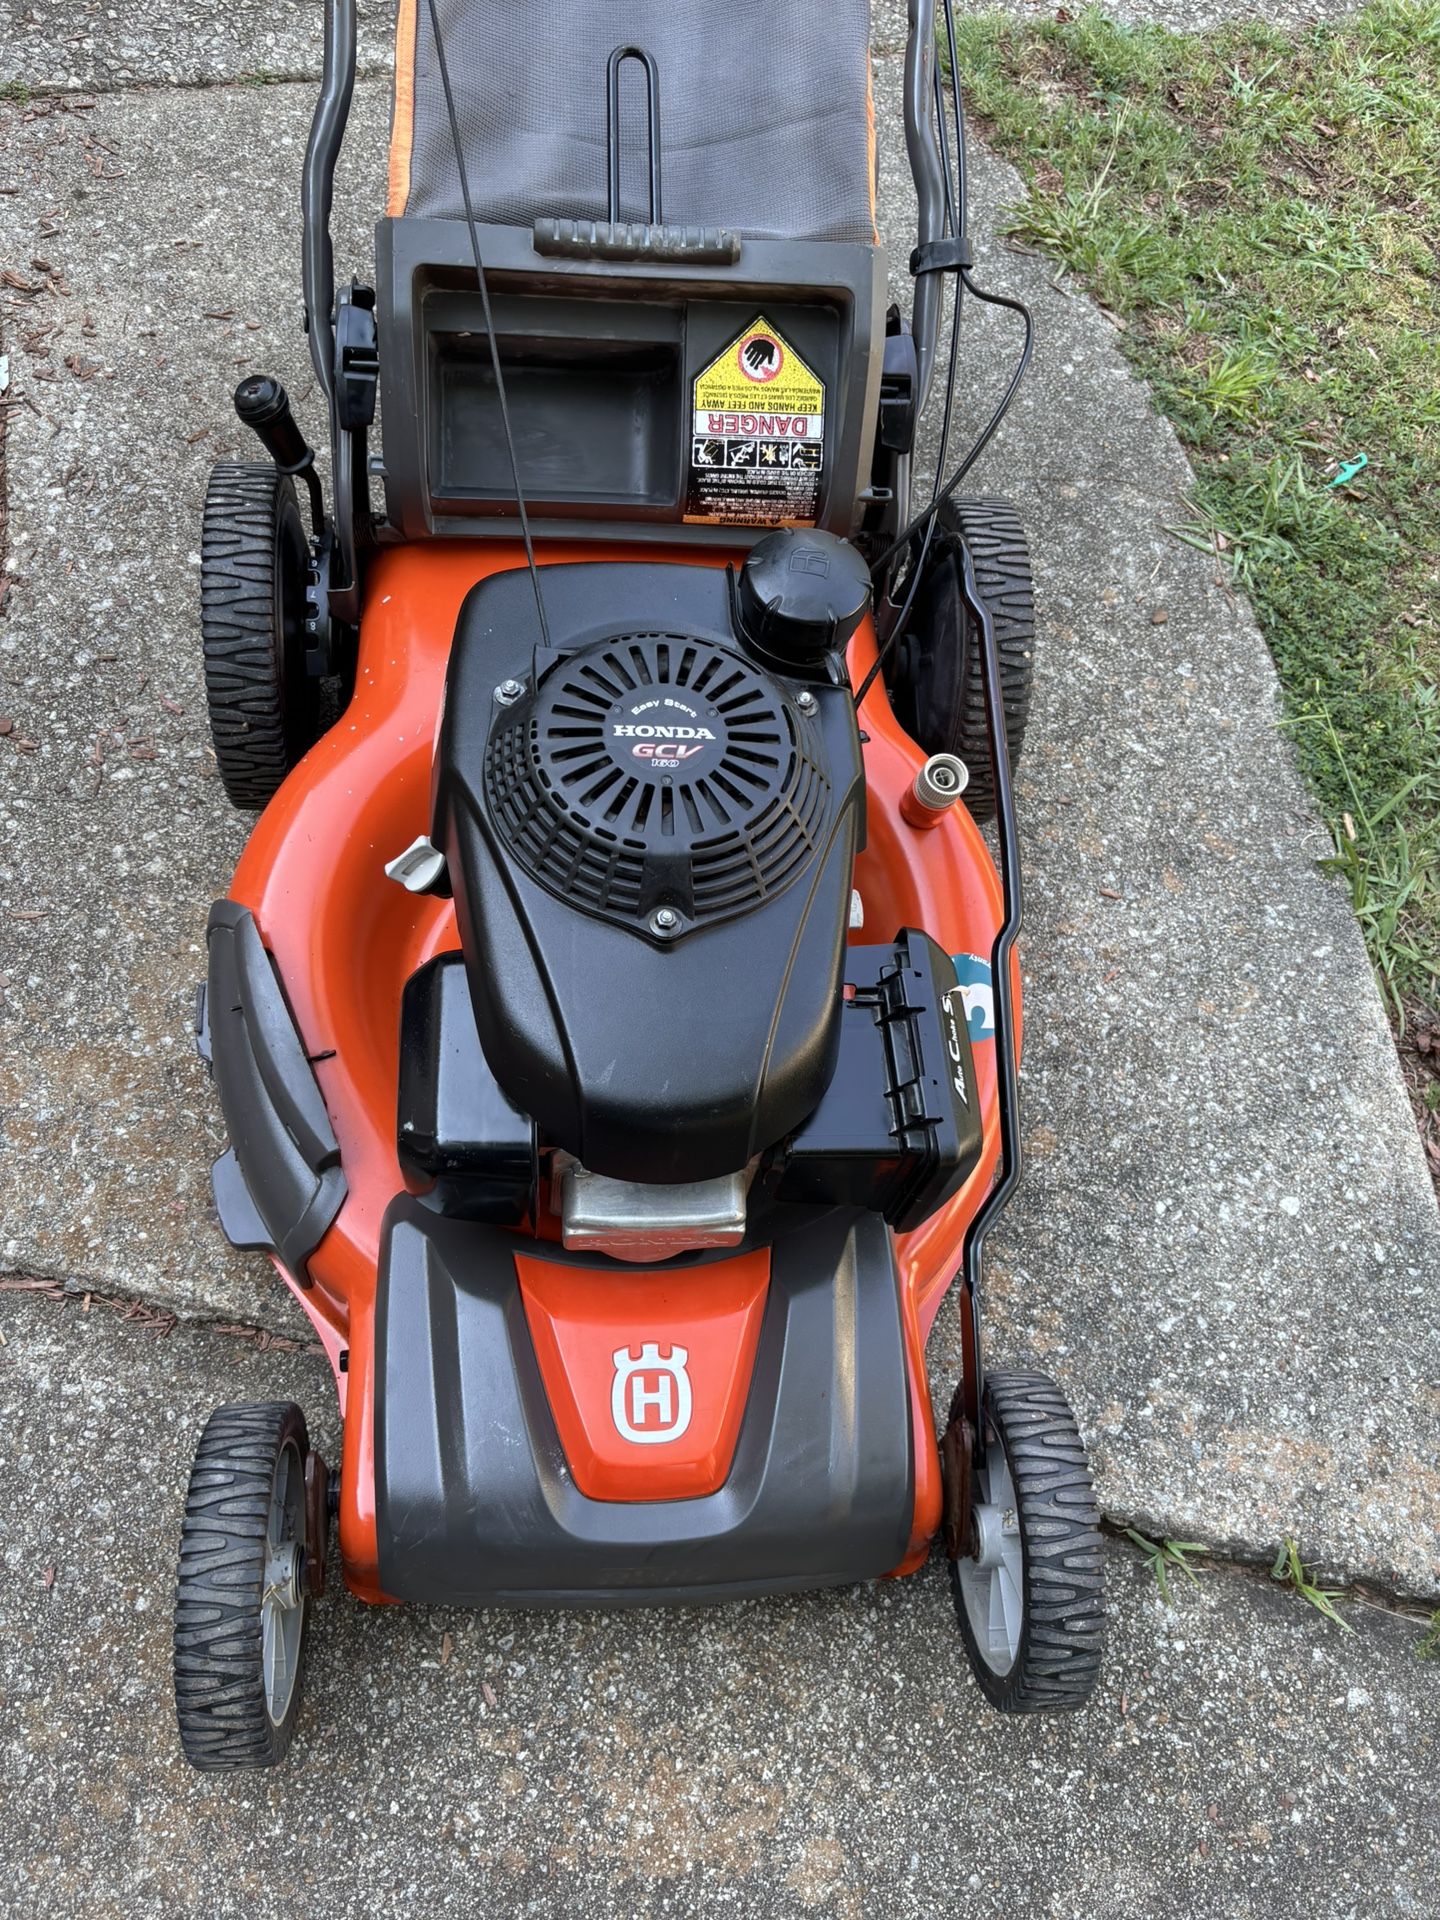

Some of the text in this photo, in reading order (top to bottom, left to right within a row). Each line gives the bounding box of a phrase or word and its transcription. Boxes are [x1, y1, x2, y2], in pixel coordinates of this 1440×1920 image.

[701, 399, 817, 412] KEEP HANDS AND FEET AWAY
[708, 414, 807, 436] DANGER
[719, 517, 767, 525] WARNING
[310, 590, 316, 598] 7
[310, 621, 316, 631] 8
[631, 698, 697, 719] Easy Start
[613, 724, 716, 740] HONDA
[631, 743, 705, 759] GCV
[651, 758, 680, 768] 160
[953, 1065, 968, 1105] Auto
[631, 1375, 672, 1425] H
